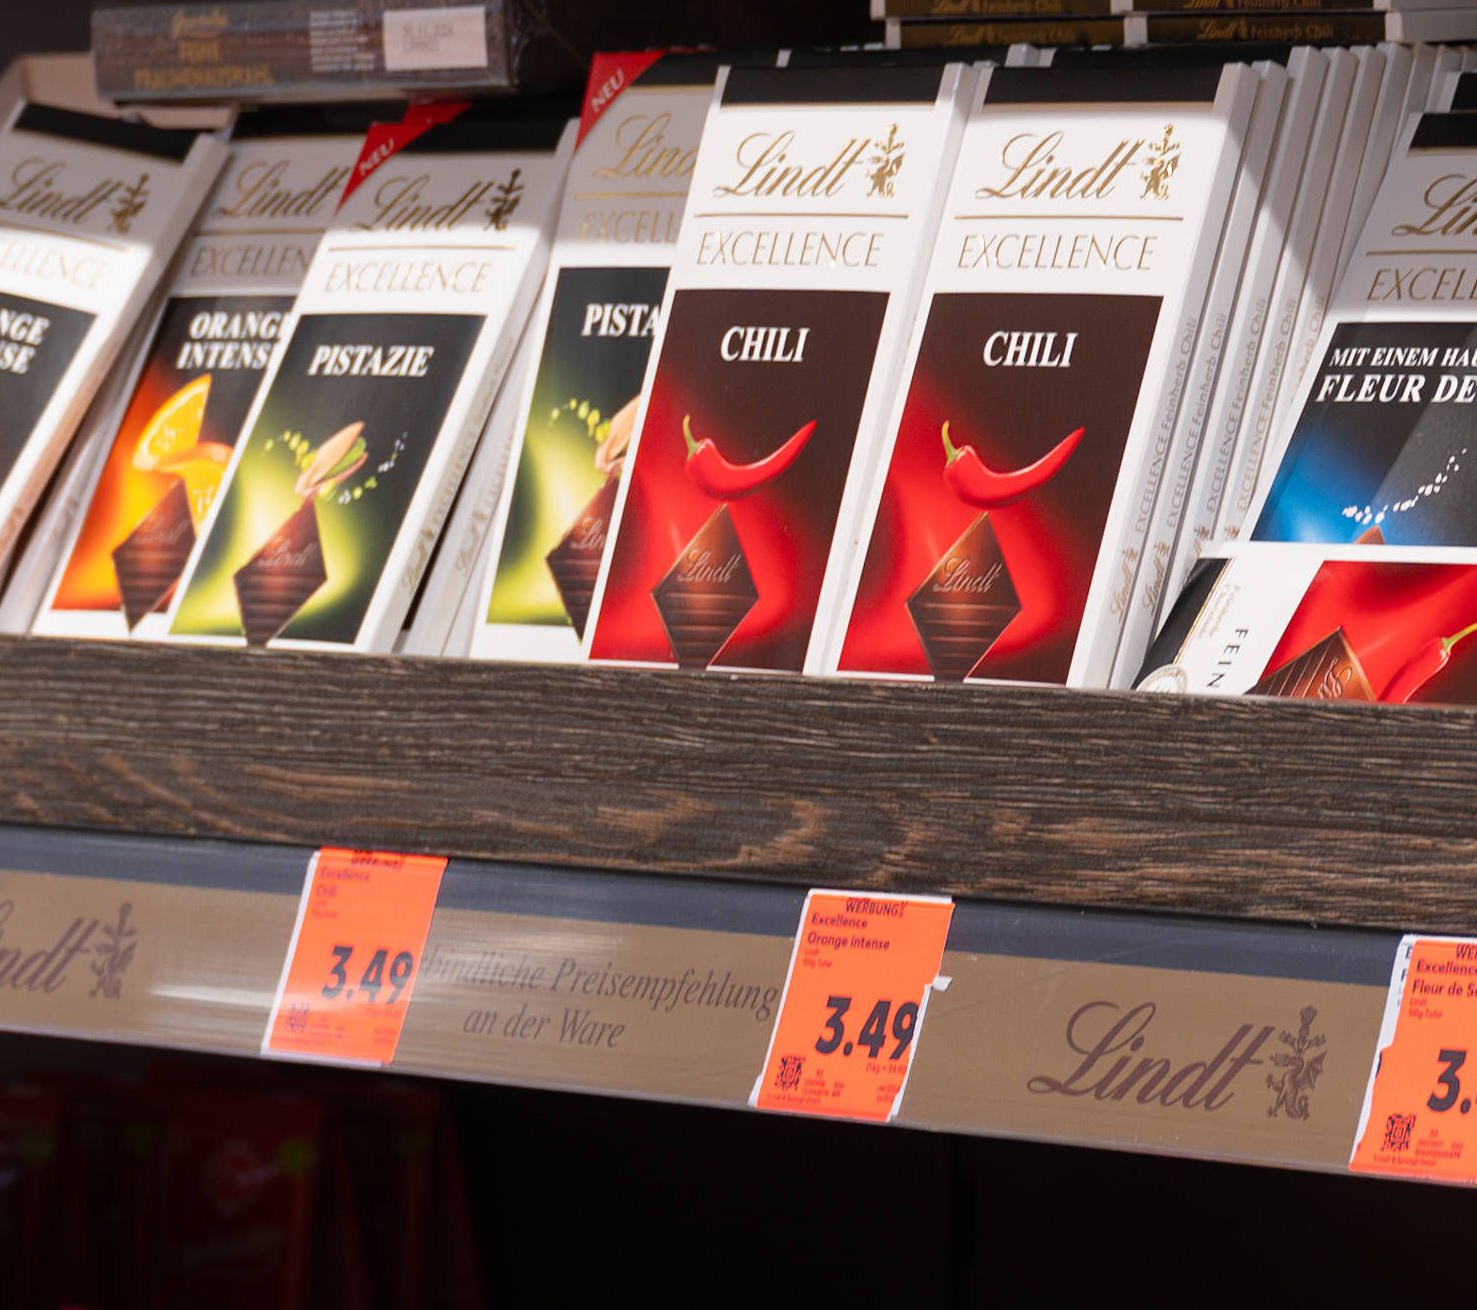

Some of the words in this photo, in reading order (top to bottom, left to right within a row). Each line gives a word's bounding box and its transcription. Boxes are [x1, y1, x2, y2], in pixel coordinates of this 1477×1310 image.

[714, 130, 865, 200] Lindt
[975, 131, 1141, 203] Lindt
[695, 231, 885, 269] EXCELLENCE
[957, 233, 1161, 272] EXCELLENCE
[307, 343, 436, 378] PISTAZIE
[721, 327, 811, 364] CHILI
[982, 330, 1079, 369] CHILI
[1329, 347, 1369, 369] MIT
[1371, 347, 1436, 369] EINEM
[1315, 374, 1424, 404] FLEUR
[1432, 374, 1477, 404] DE
[811, 912, 868, 929] Excellence
[807, 932, 848, 951] Orange
[850, 935, 890, 951] intense
[321, 944, 415, 1007] 3.49
[549, 958, 781, 1022] Preisempfehlung
[1411, 979, 1444, 997] Fleur
[1447, 981, 1464, 997] de
[462, 1009, 496, 1037] an
[502, 1007, 551, 1042] der
[557, 1010, 626, 1049] Ware
[815, 996, 919, 1061] 3.49
[1027, 1000, 1276, 1111] Lindt
